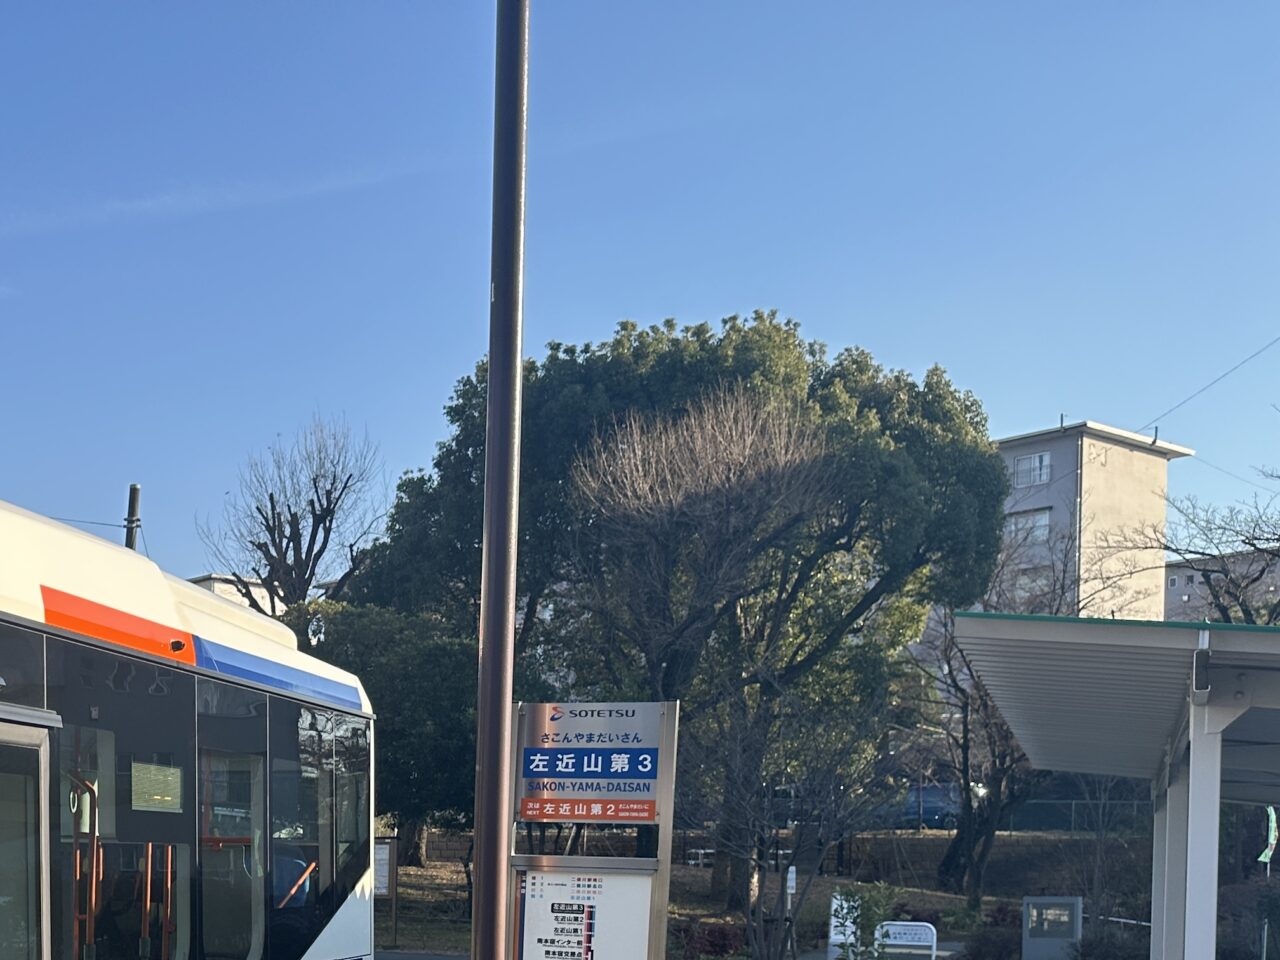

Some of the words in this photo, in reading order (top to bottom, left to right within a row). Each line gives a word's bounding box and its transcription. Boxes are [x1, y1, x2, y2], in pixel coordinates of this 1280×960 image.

[569, 709, 636, 718] SOTETSU
[541, 732, 642, 744] さこんやまだいさん
[529, 753, 652, 773] 左近山第3
[527, 781, 651, 793] SAKON-YAMA-DAISAN
[543, 803, 615, 816] 左近山第2
